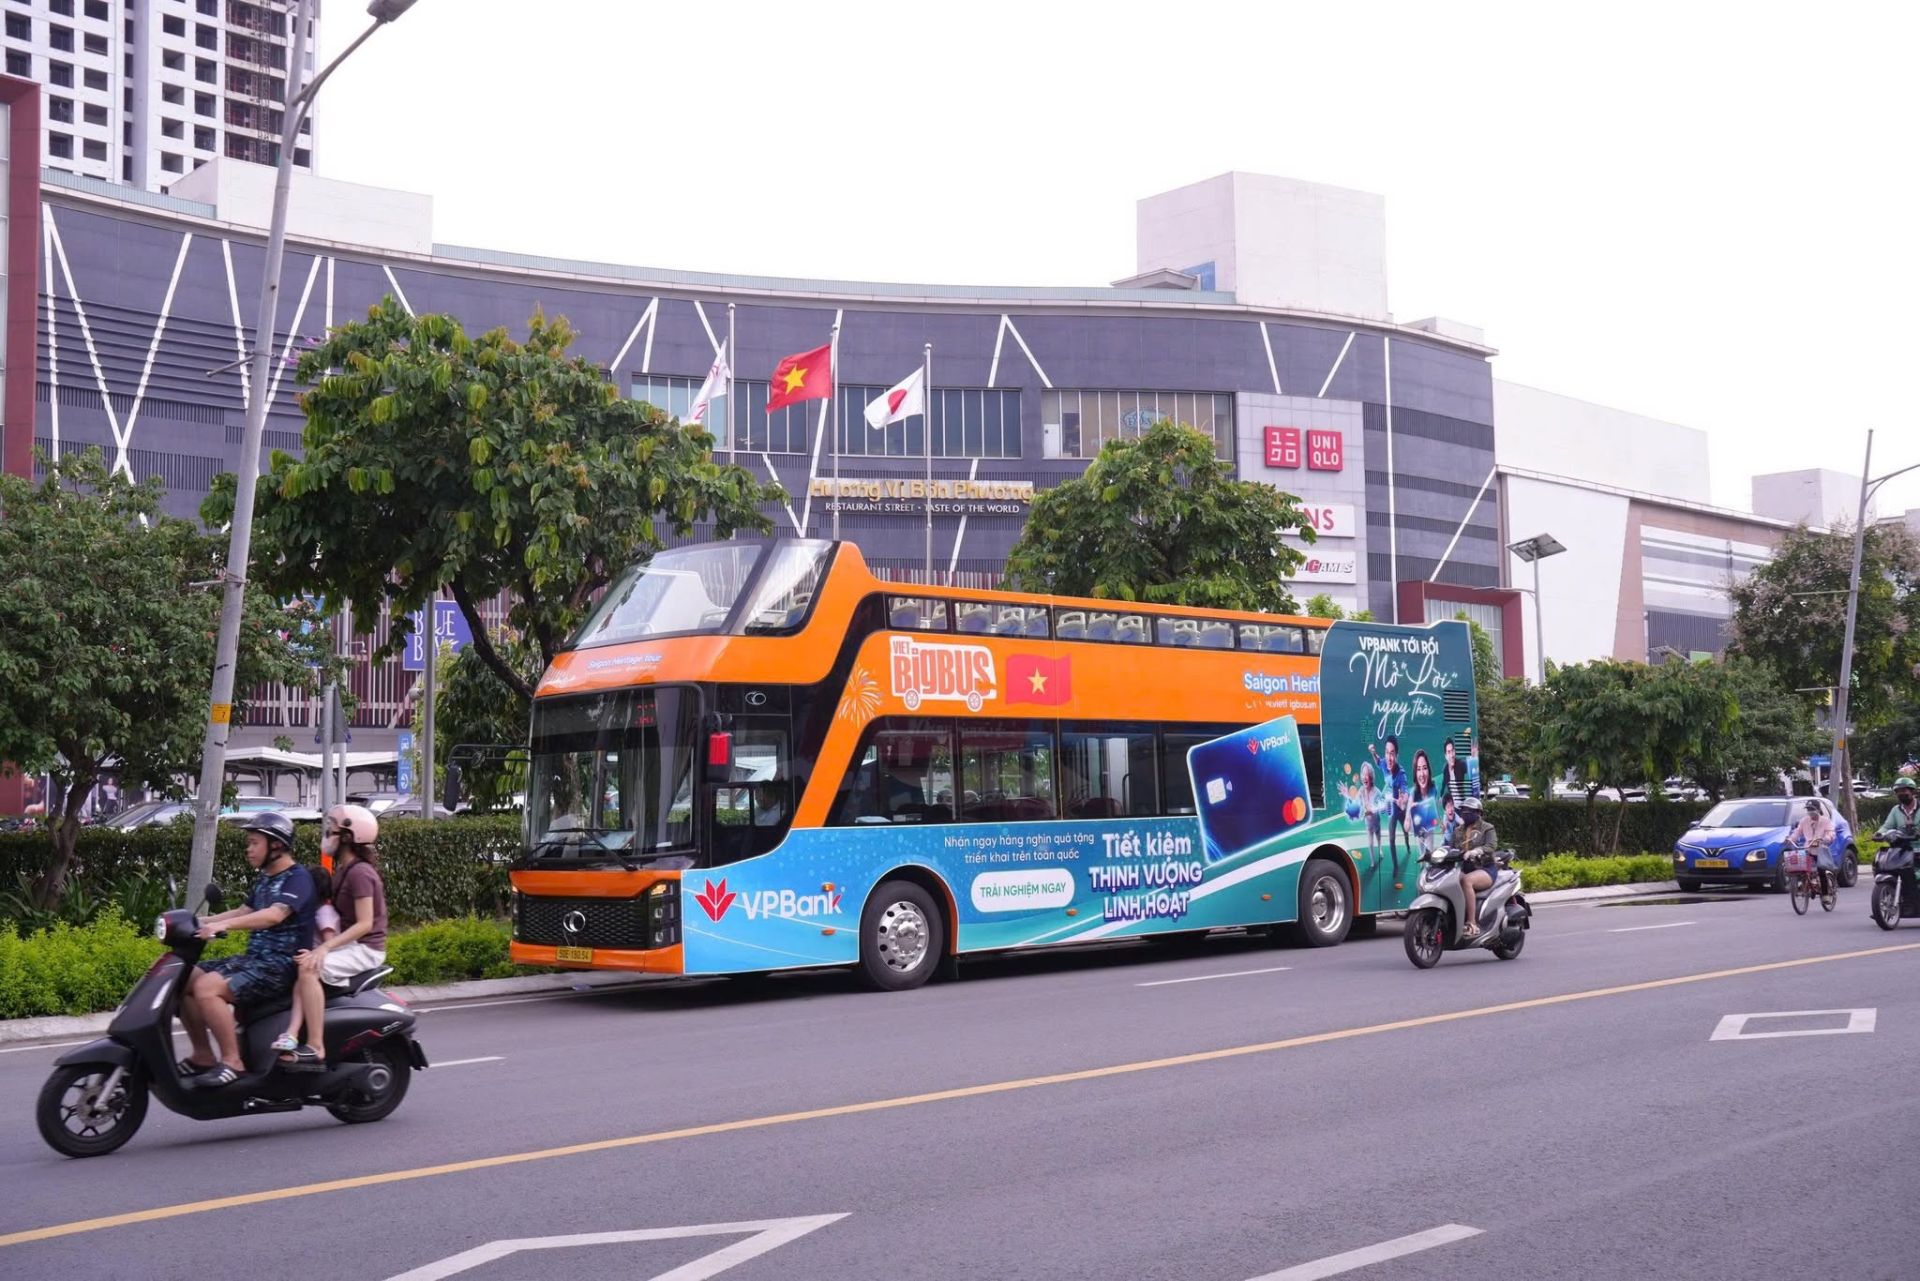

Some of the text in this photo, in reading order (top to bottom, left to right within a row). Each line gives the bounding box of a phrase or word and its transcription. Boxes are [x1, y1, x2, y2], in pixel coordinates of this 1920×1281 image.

[1271, 431, 1297, 447] ユニ
[1312, 434, 1337, 450] UNI
[1270, 448, 1297, 463] クロ
[1313, 450, 1339, 467] QLO
[825, 502, 882, 512] RESTAURANT
[884, 503, 915, 512] STREET
[952, 504, 965, 513] OF
[967, 504, 985, 513] THE
[987, 504, 1020, 513] WORLD
[413, 610, 456, 636] BUE
[413, 635, 445, 662] BY
[892, 640, 910, 655] VIET
[1358, 635, 1401, 653] VPBANK
[1243, 672, 1288, 695] Saigon
[944, 835, 971, 850] Nhận
[972, 837, 998, 850] ngay
[1101, 830, 1192, 863] Tiết kiệm
[989, 851, 1010, 863] khai
[1012, 851, 1031, 862] trên
[1056, 847, 1080, 863] quốc
[1088, 860, 1203, 893] THỊNH VƯỢNG
[1003, 881, 1040, 898] NGHIỆM
[1041, 882, 1066, 895] NGAY
[741, 889, 843, 920] VPBank
[1103, 891, 1190, 919] LINH HOẠT
